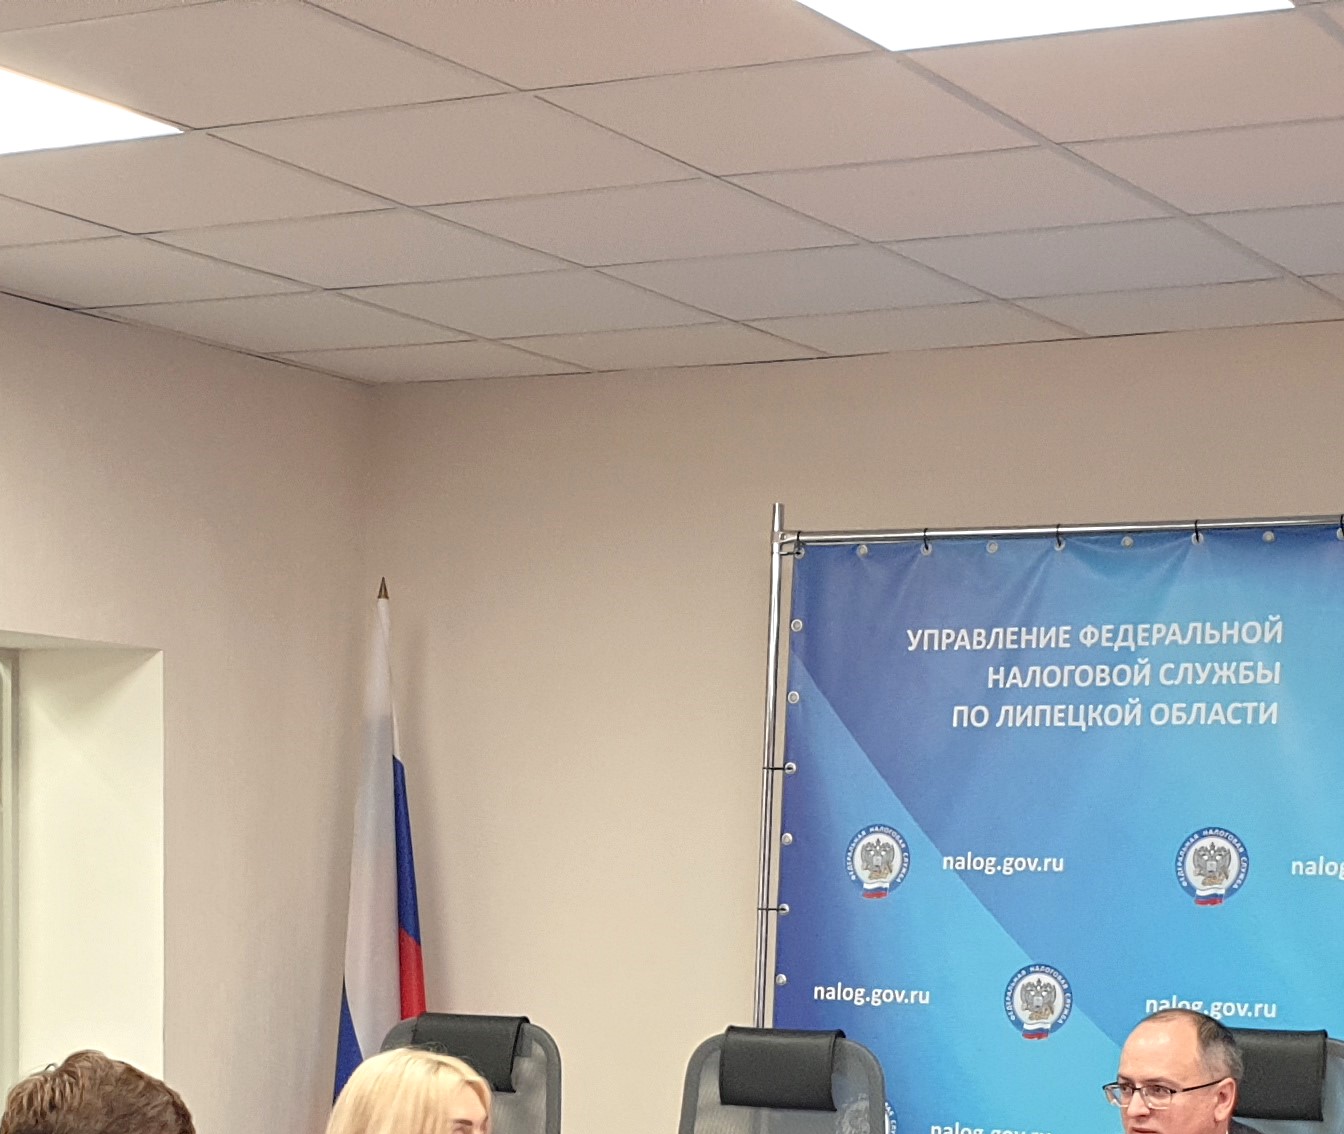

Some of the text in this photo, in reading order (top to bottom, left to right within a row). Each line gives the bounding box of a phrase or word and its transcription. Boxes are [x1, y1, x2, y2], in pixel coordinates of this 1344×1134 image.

[906, 614, 1283, 652] УПРАВЛЕНИЕ ФЕДЕРАЛЬНОЙ
[987, 657, 1281, 689] НАЛОГОВОЙ СЛУЖБЫ
[952, 697, 1278, 732] ПО ЛИПЕЦКОЙ ОБЛАСТИ
[942, 851, 1064, 876] nalog.gov.ru
[813, 981, 930, 1007] nalog.gov.ru
